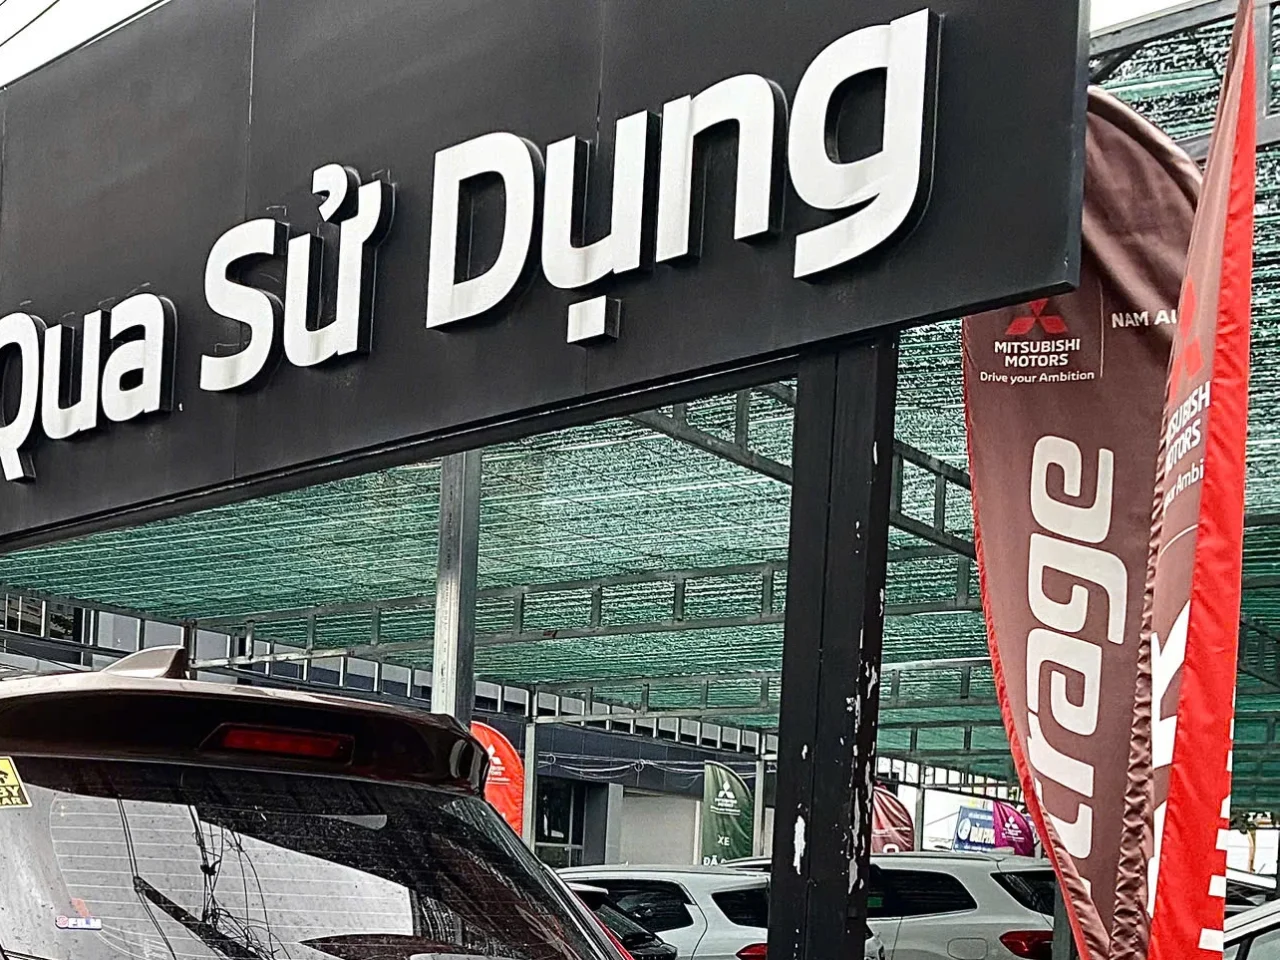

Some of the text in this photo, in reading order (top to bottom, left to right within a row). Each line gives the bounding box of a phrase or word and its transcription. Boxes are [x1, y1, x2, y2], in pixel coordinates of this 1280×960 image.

[199, 164, 384, 392] Sử
[426, 8, 930, 345] Dụng
[1111, 310, 1150, 328] NAM
[994, 338, 1081, 354] MITSUBISHI
[1004, 353, 1069, 368] MOTORS
[979, 370, 1095, 385] Drive your Ambition
[717, 834, 730, 846] XE
